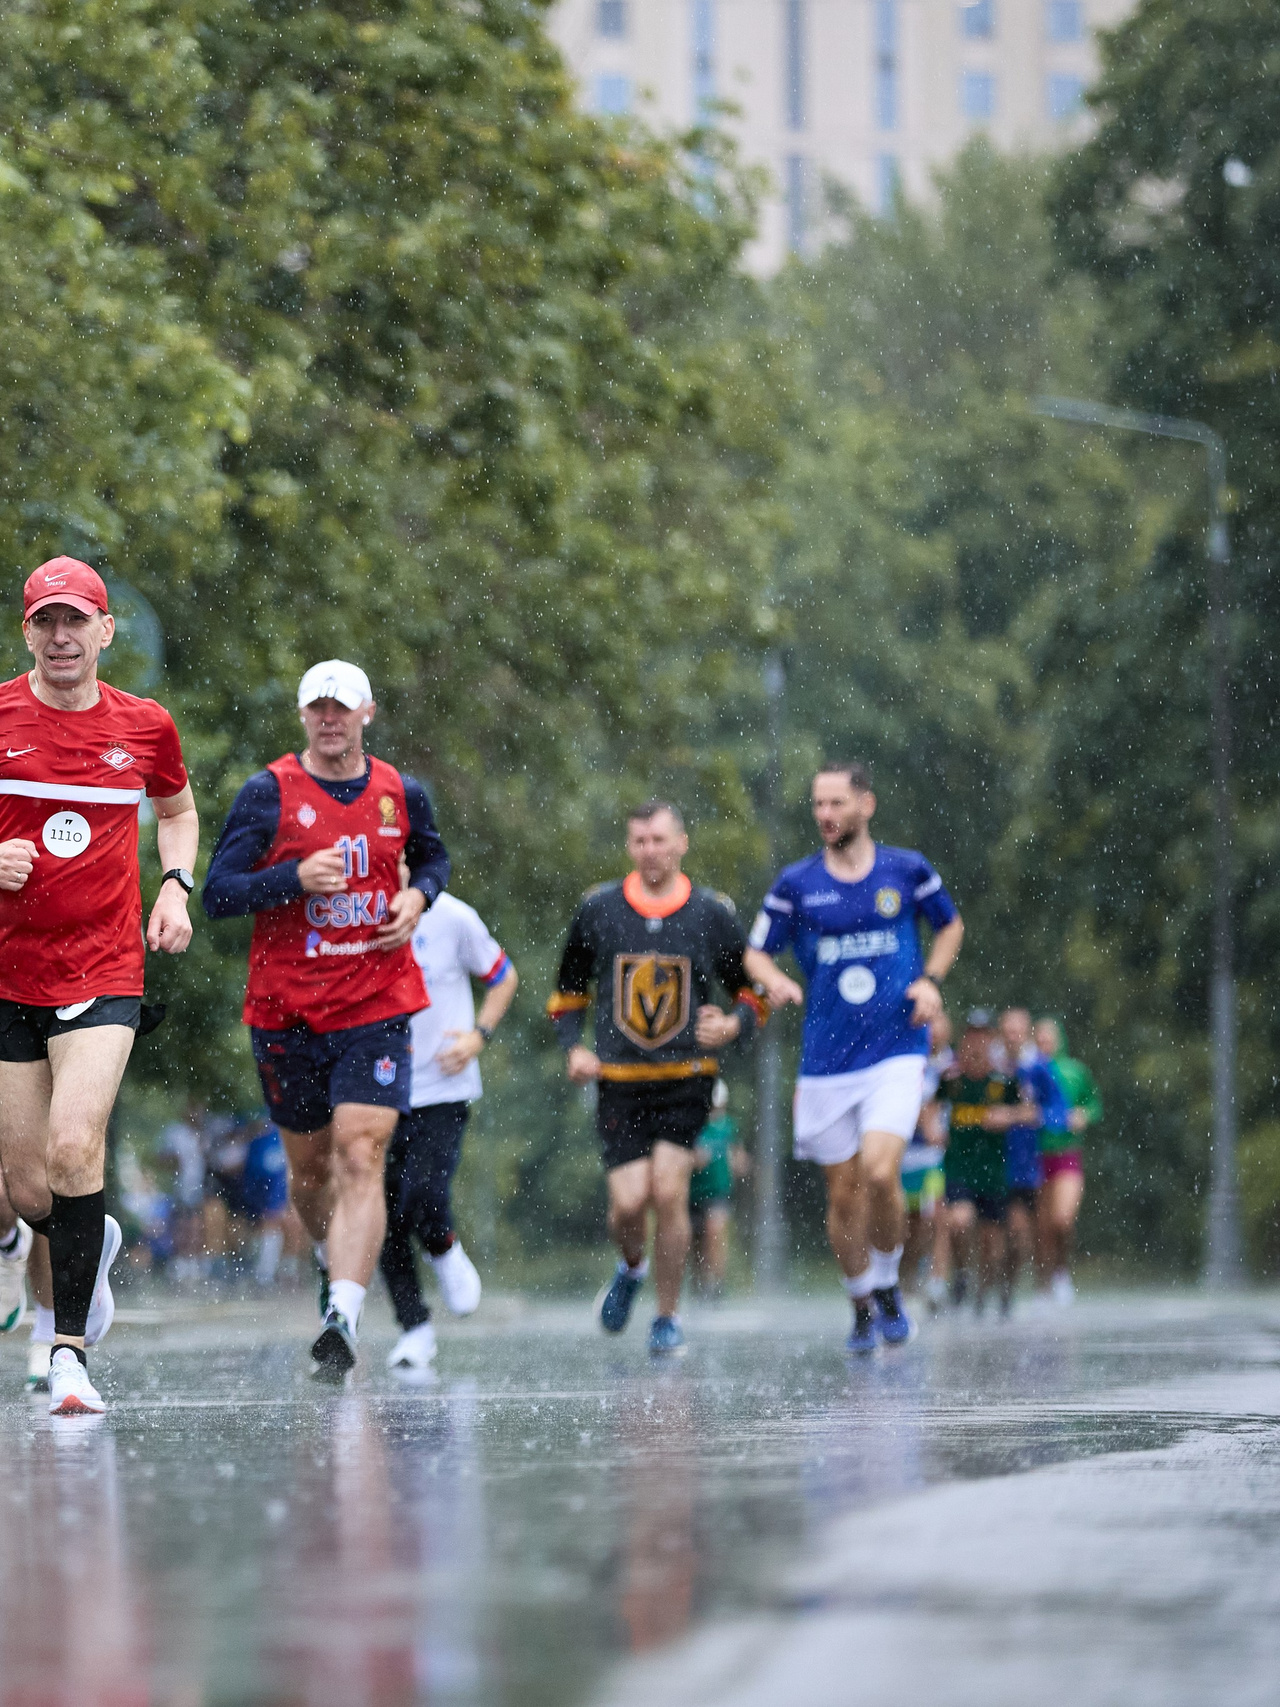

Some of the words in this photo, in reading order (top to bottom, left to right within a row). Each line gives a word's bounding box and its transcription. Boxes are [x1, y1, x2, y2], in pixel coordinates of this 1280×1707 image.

[50, 828, 83, 843] 1110
[334, 833, 369, 878] 11
[305, 889, 390, 928] CSKA
